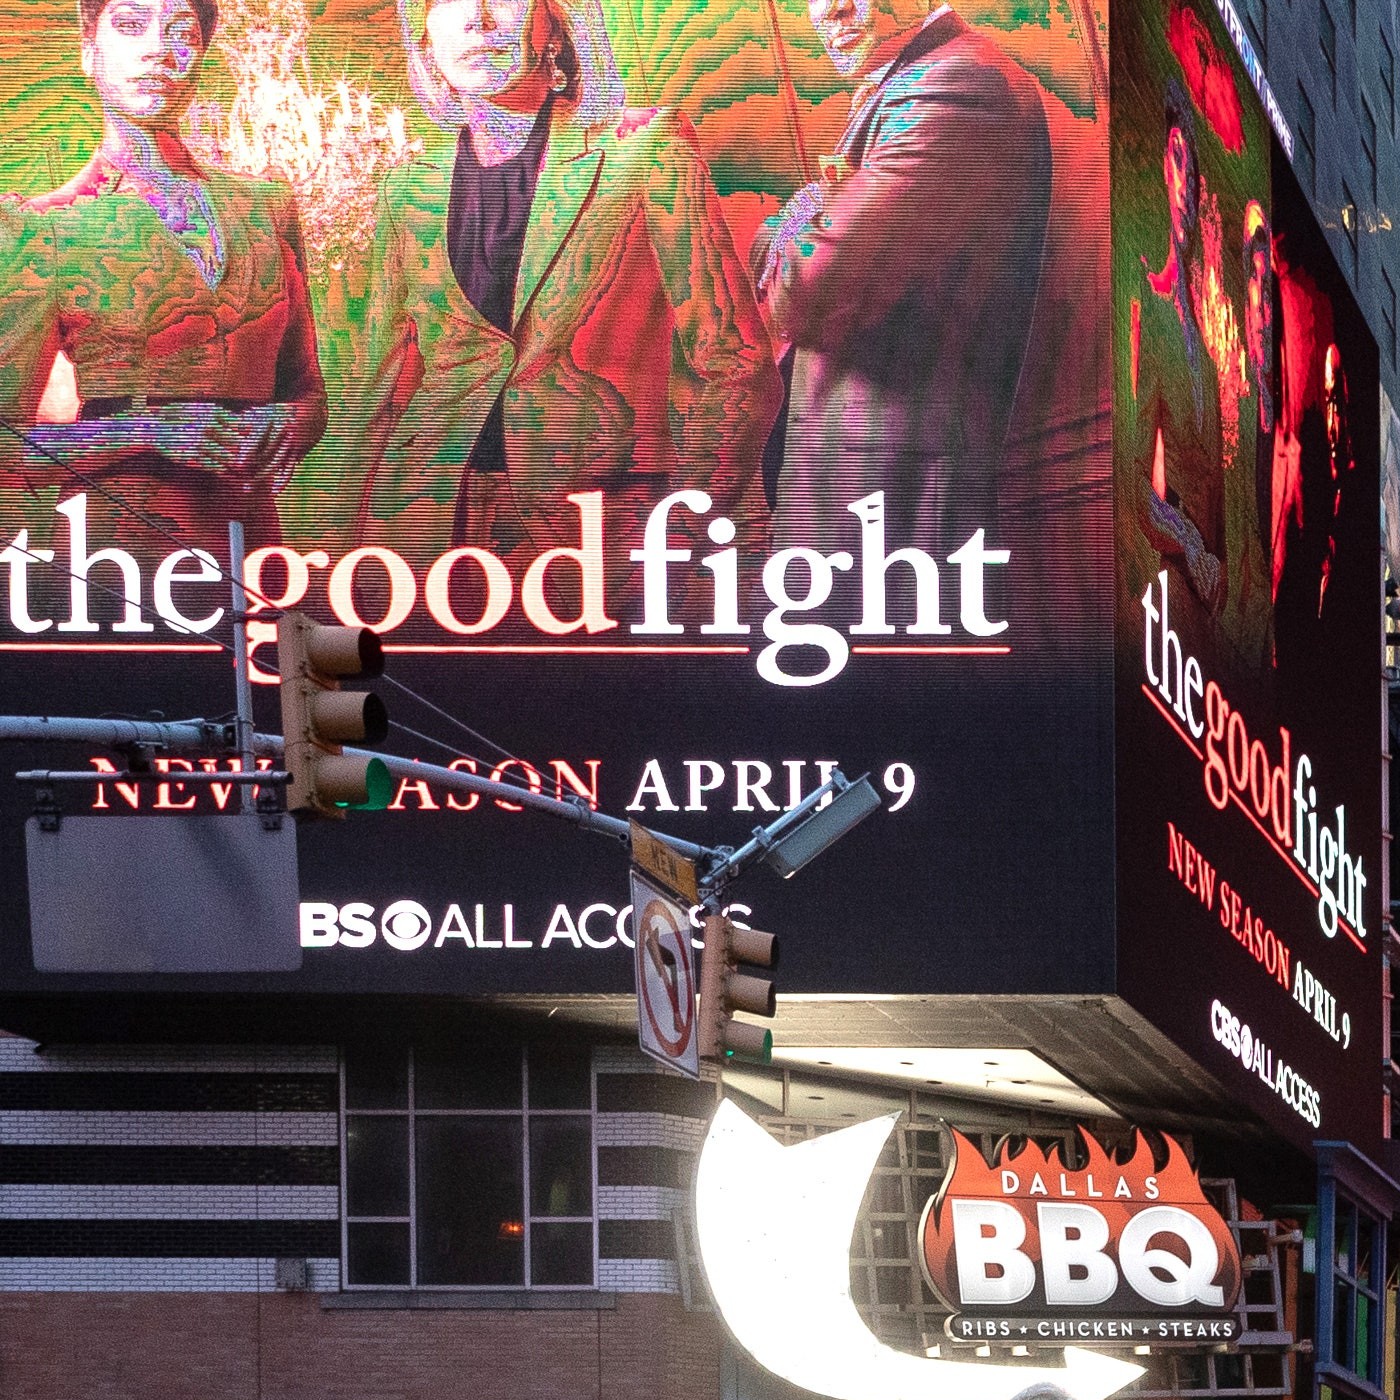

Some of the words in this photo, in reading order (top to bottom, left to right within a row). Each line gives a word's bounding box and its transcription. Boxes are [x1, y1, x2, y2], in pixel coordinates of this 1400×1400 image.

[3, 491, 228, 636] the
[243, 490, 619, 685] good
[630, 489, 1012, 688] fight
[883, 761, 917, 813] 9
[1141, 569, 1205, 739] the
[1204, 681, 1293, 847] good
[1293, 754, 1367, 939] fight
[650, 843, 680, 884] NEW
[299, 901, 377, 950] BS
[433, 903, 533, 949] ALL
[1168, 821, 1216, 912] NEW
[1219, 880, 1290, 992] SEASON
[1292, 960, 1341, 1043] APRIL
[1341, 1012, 1351, 1050] 9
[1211, 999, 1241, 1058] CBS
[1252, 1038, 1276, 1091] ALL
[1275, 1059, 1321, 1129] ACCESS
[1001, 1169, 1160, 1199] DALLAS
[951, 1197, 1225, 1309] BBQ
[961, 1320, 1011, 1338] RIBS
[1037, 1320, 1134, 1338] CHICKEN
[1158, 1320, 1234, 1338] STEAKS
